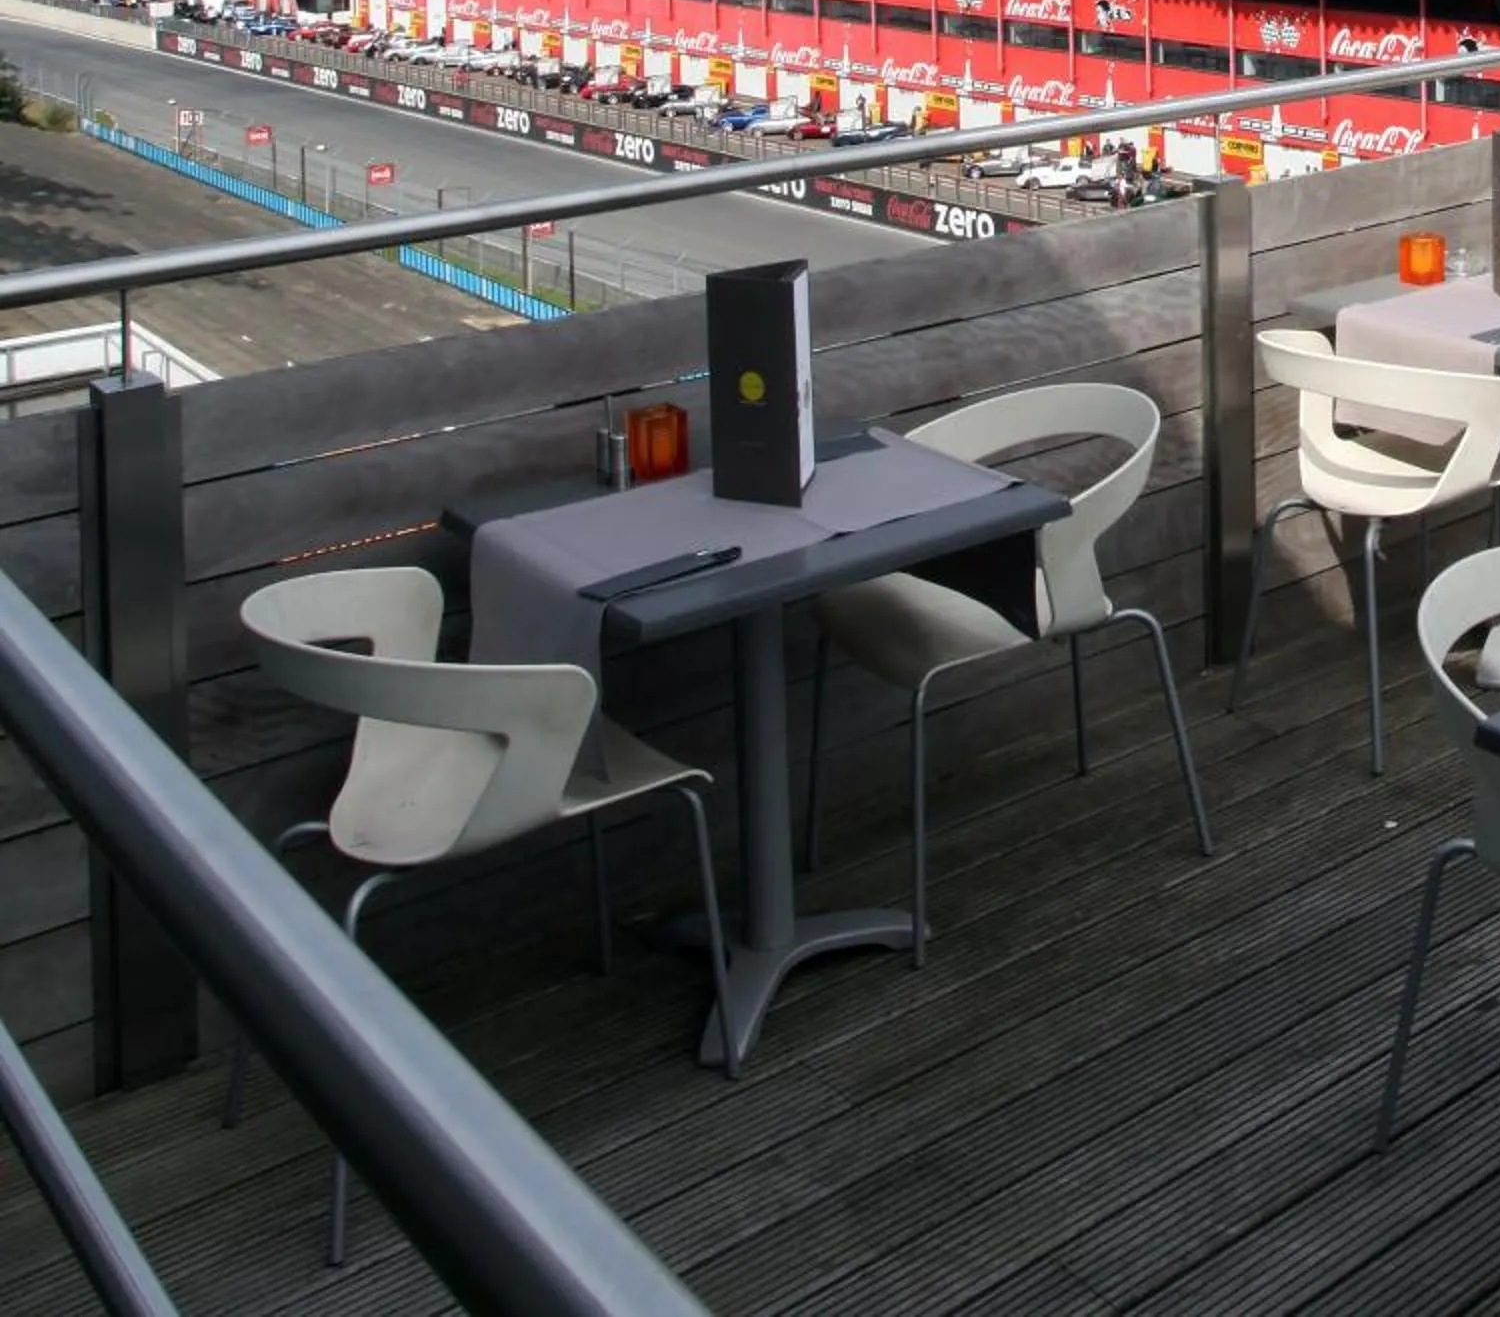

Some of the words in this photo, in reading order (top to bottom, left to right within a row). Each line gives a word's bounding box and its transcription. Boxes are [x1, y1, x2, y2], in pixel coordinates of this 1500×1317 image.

[397, 84, 426, 110] zero
[496, 106, 529, 133] zero
[614, 132, 655, 163] zero
[934, 203, 995, 238] zero
